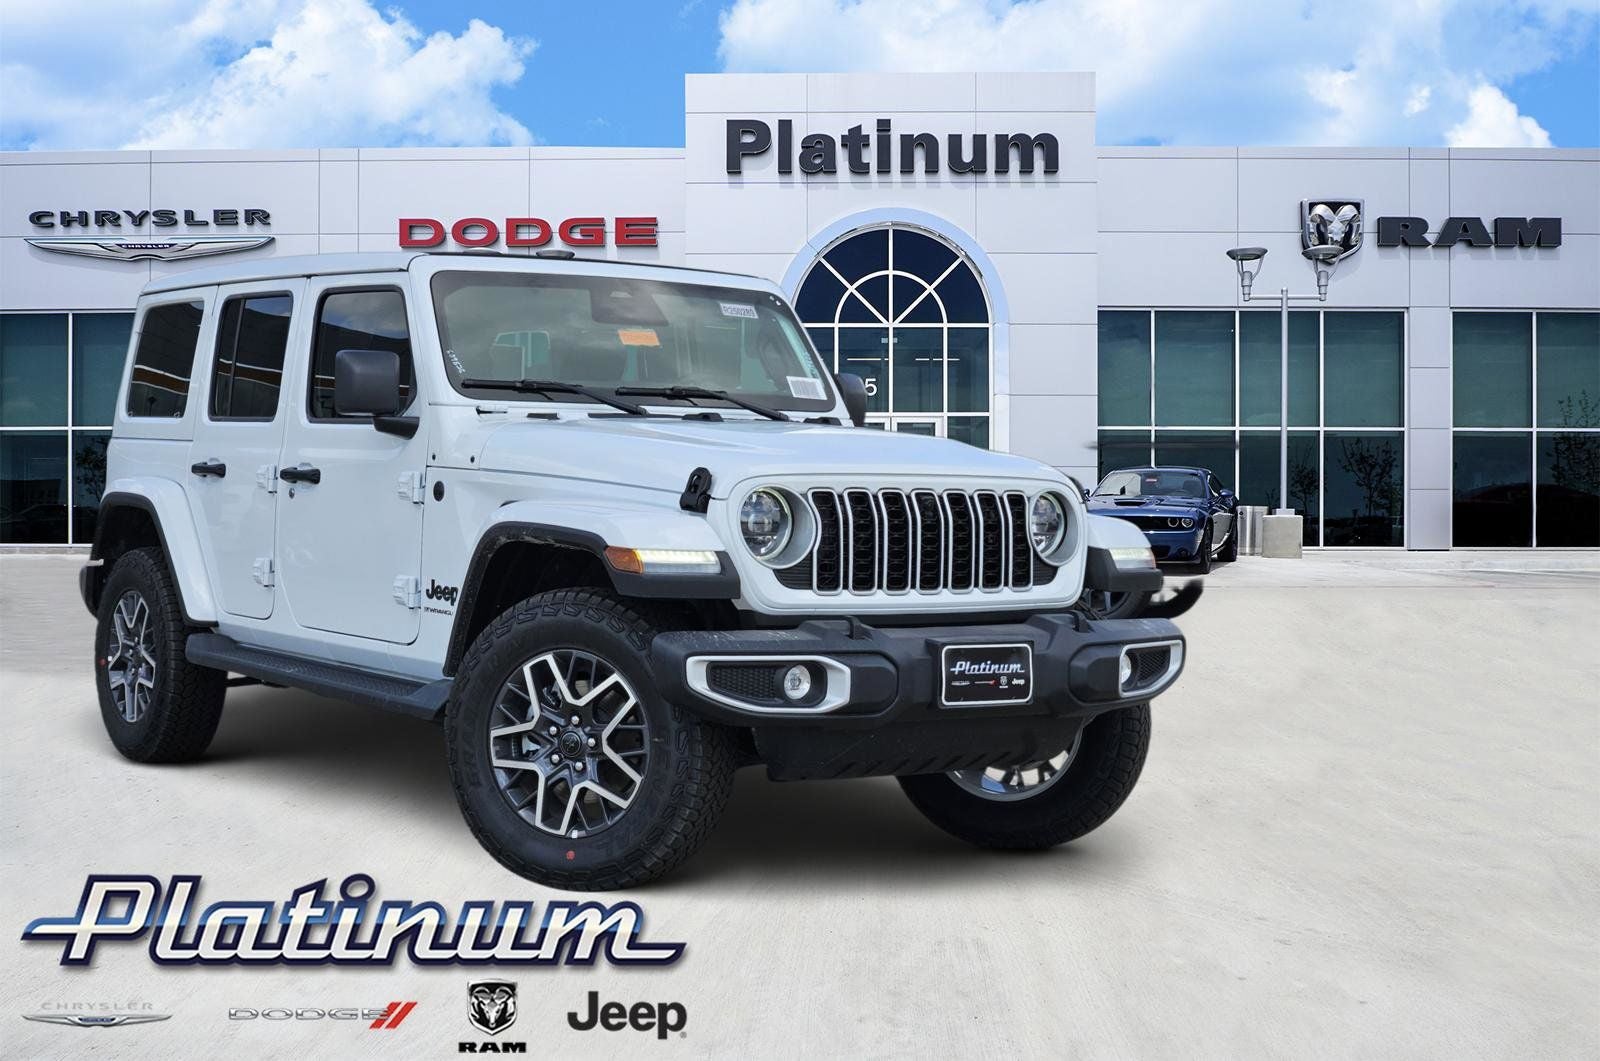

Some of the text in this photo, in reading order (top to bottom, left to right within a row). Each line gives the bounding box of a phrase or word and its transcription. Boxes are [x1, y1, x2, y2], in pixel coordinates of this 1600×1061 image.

[726, 118, 1060, 175] Platinum
[28, 208, 272, 228] CHRYSLER
[399, 216, 658, 247] DODGE
[1376, 216, 1562, 247] RAM
[425, 579, 459, 607] Jeep
[950, 660, 1025, 675] Platinum
